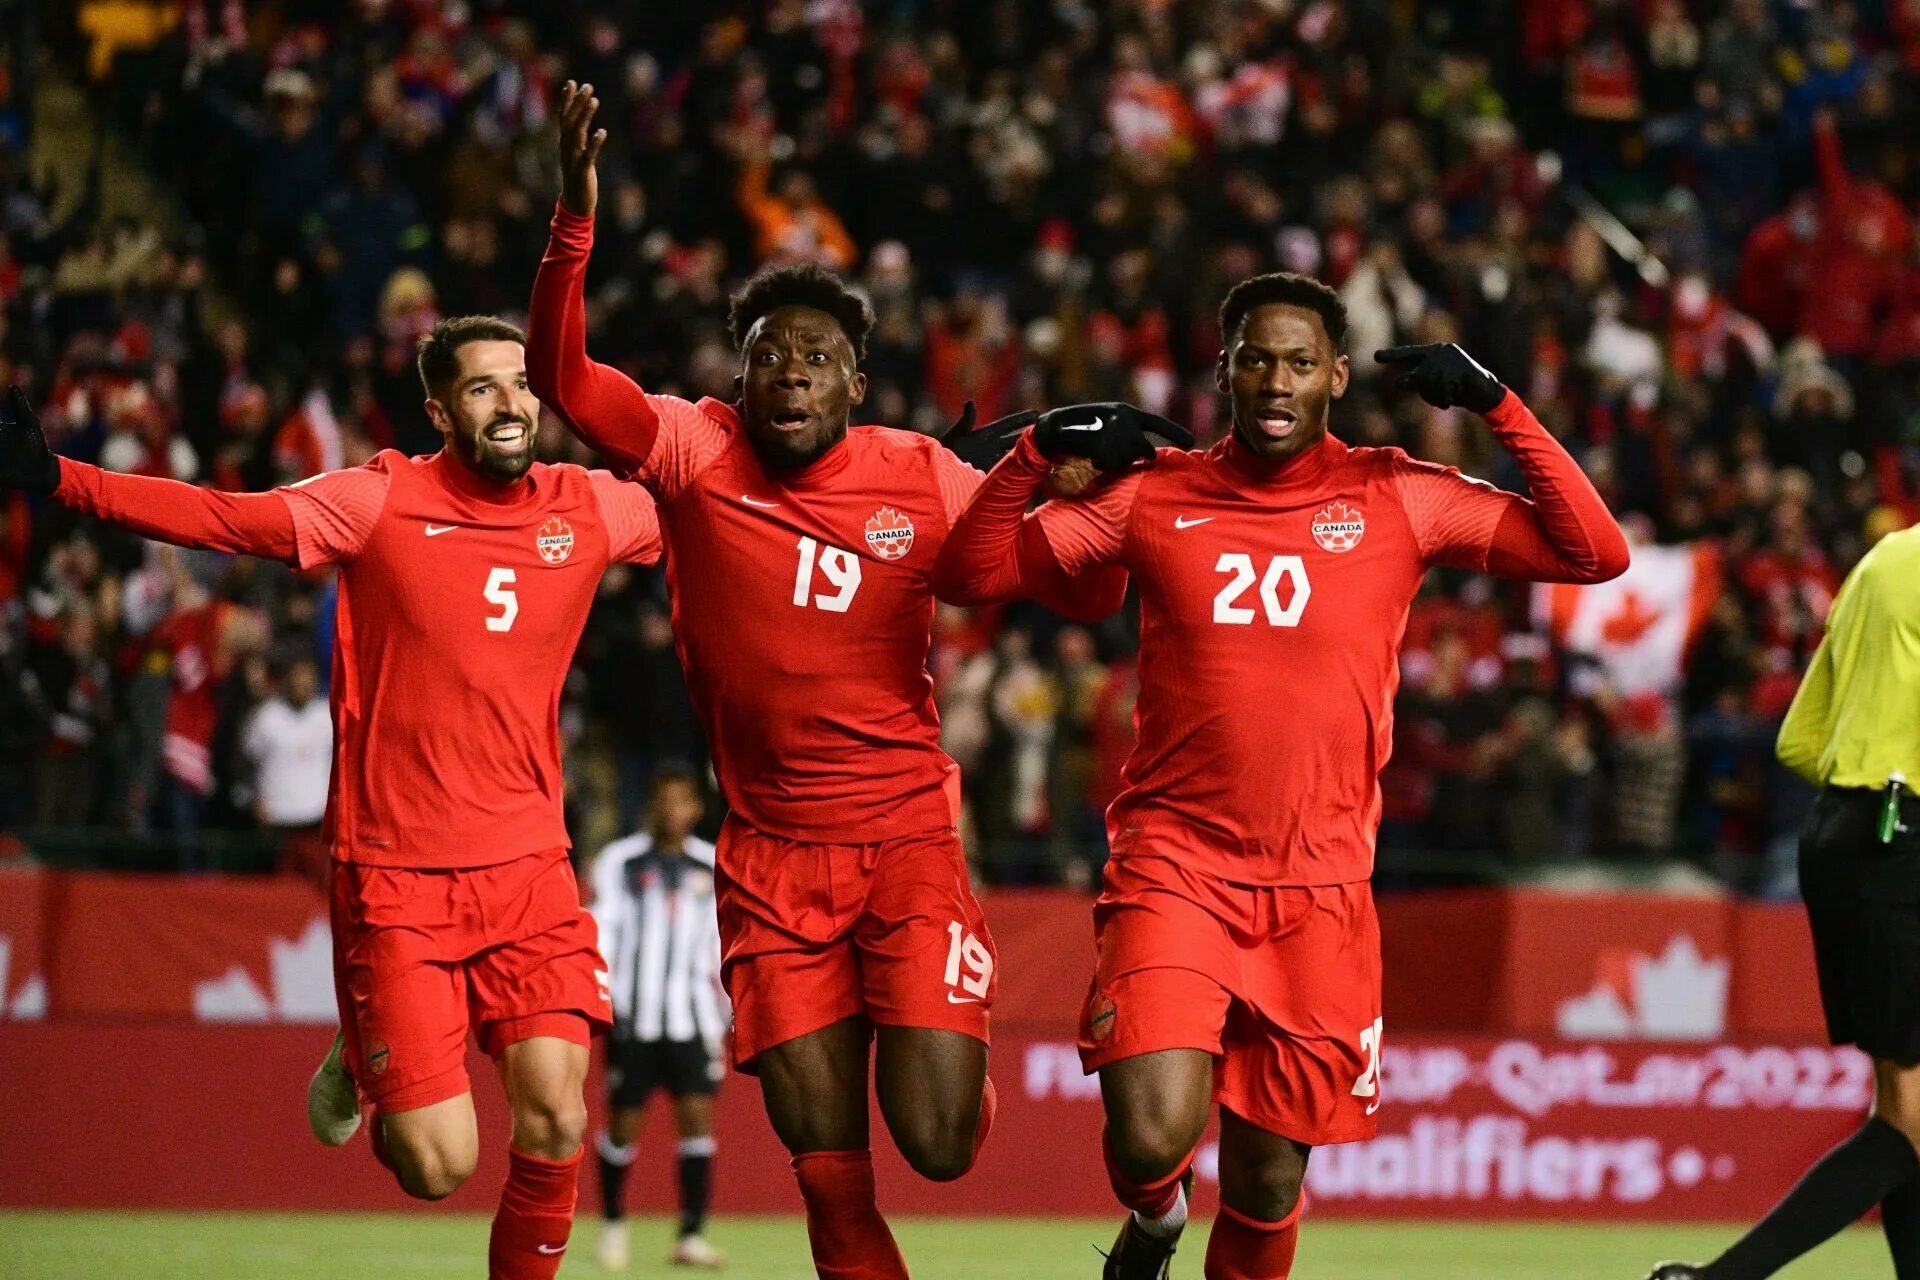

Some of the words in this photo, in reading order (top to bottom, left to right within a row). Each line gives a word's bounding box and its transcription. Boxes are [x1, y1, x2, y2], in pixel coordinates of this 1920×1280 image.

[538, 536, 571, 546] CANADA
[867, 529, 912, 541] CANADA
[1314, 524, 1362, 533] CANADA
[483, 567, 519, 632] 5
[793, 535, 862, 613] 19
[1213, 553, 1312, 627] 20
[944, 920, 994, 999] 19
[1304, 1115, 1663, 1201] ualifiers
